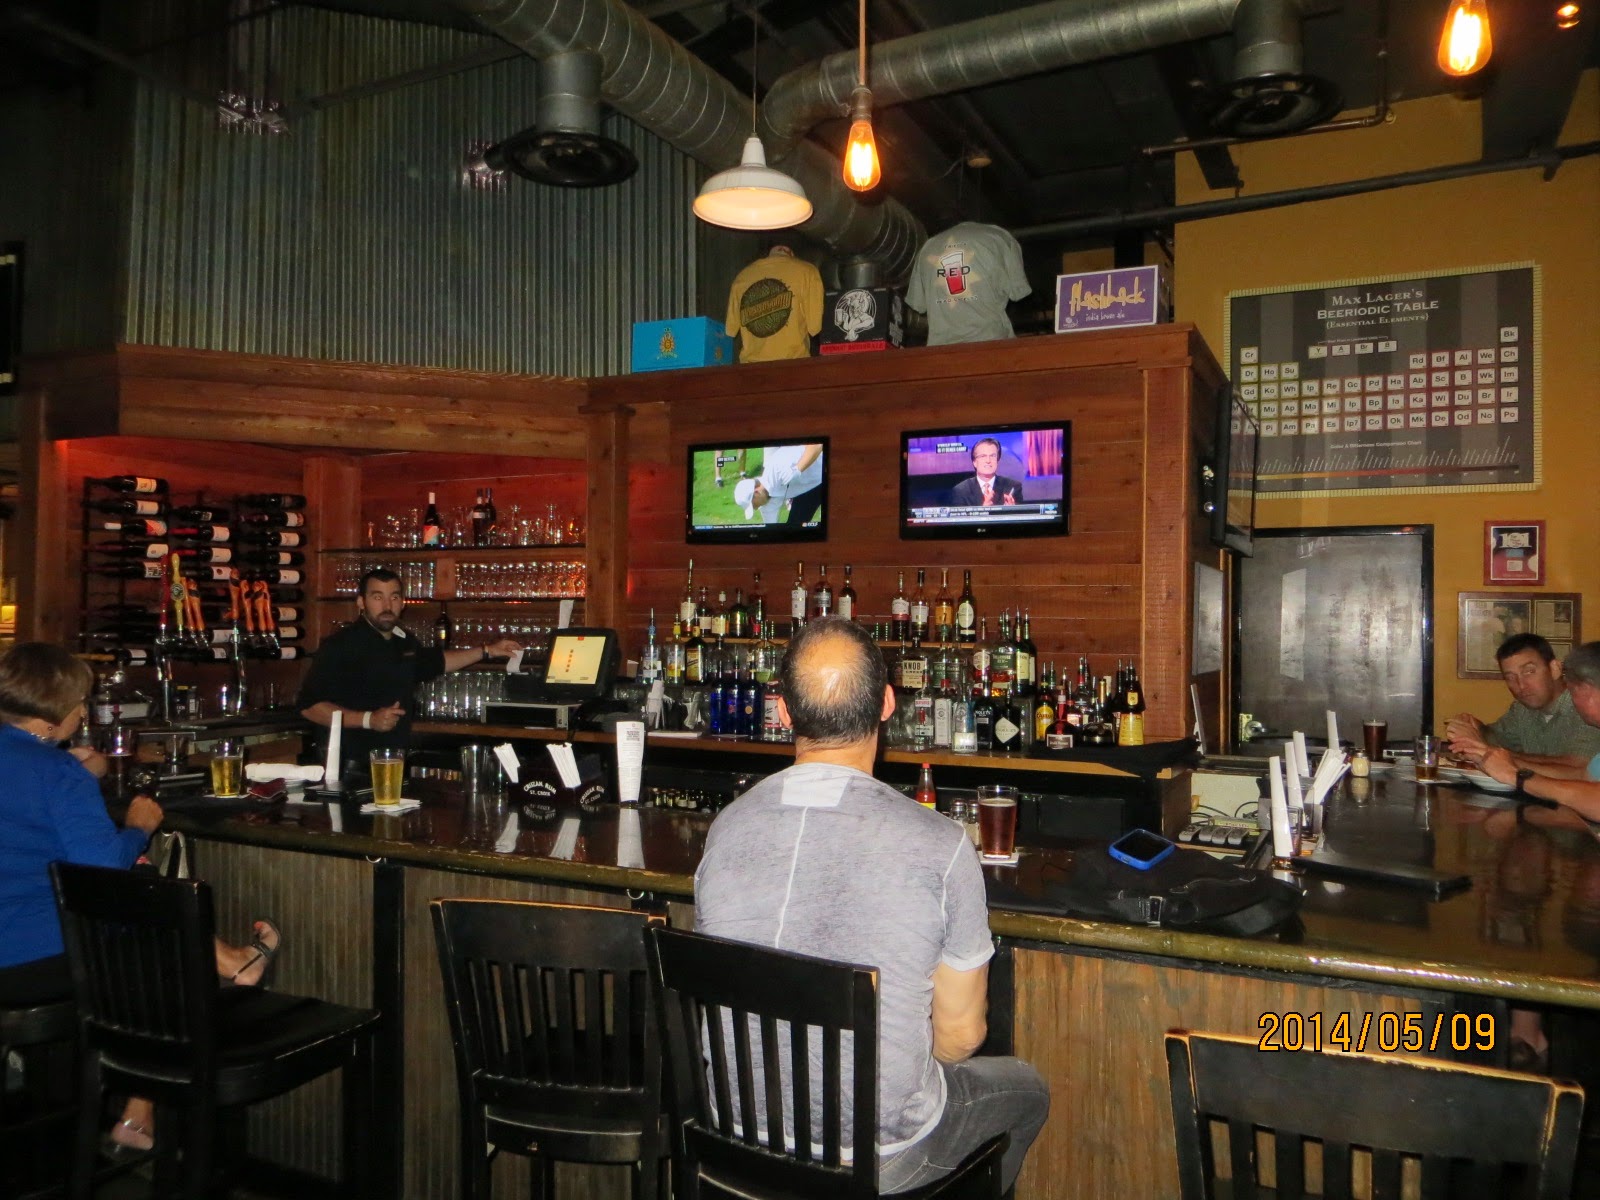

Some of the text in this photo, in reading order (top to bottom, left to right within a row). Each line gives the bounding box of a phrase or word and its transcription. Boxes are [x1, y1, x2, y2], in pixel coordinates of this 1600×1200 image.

[937, 265, 971, 277] RED
[1332, 288, 1423, 306] MAX LAGER'S
[1317, 300, 1439, 320] BEERIODIC TABLE
[1284, 405, 1295, 413] Ap
[903, 661, 920, 670] KNOB
[545, 783, 557, 794] RUM
